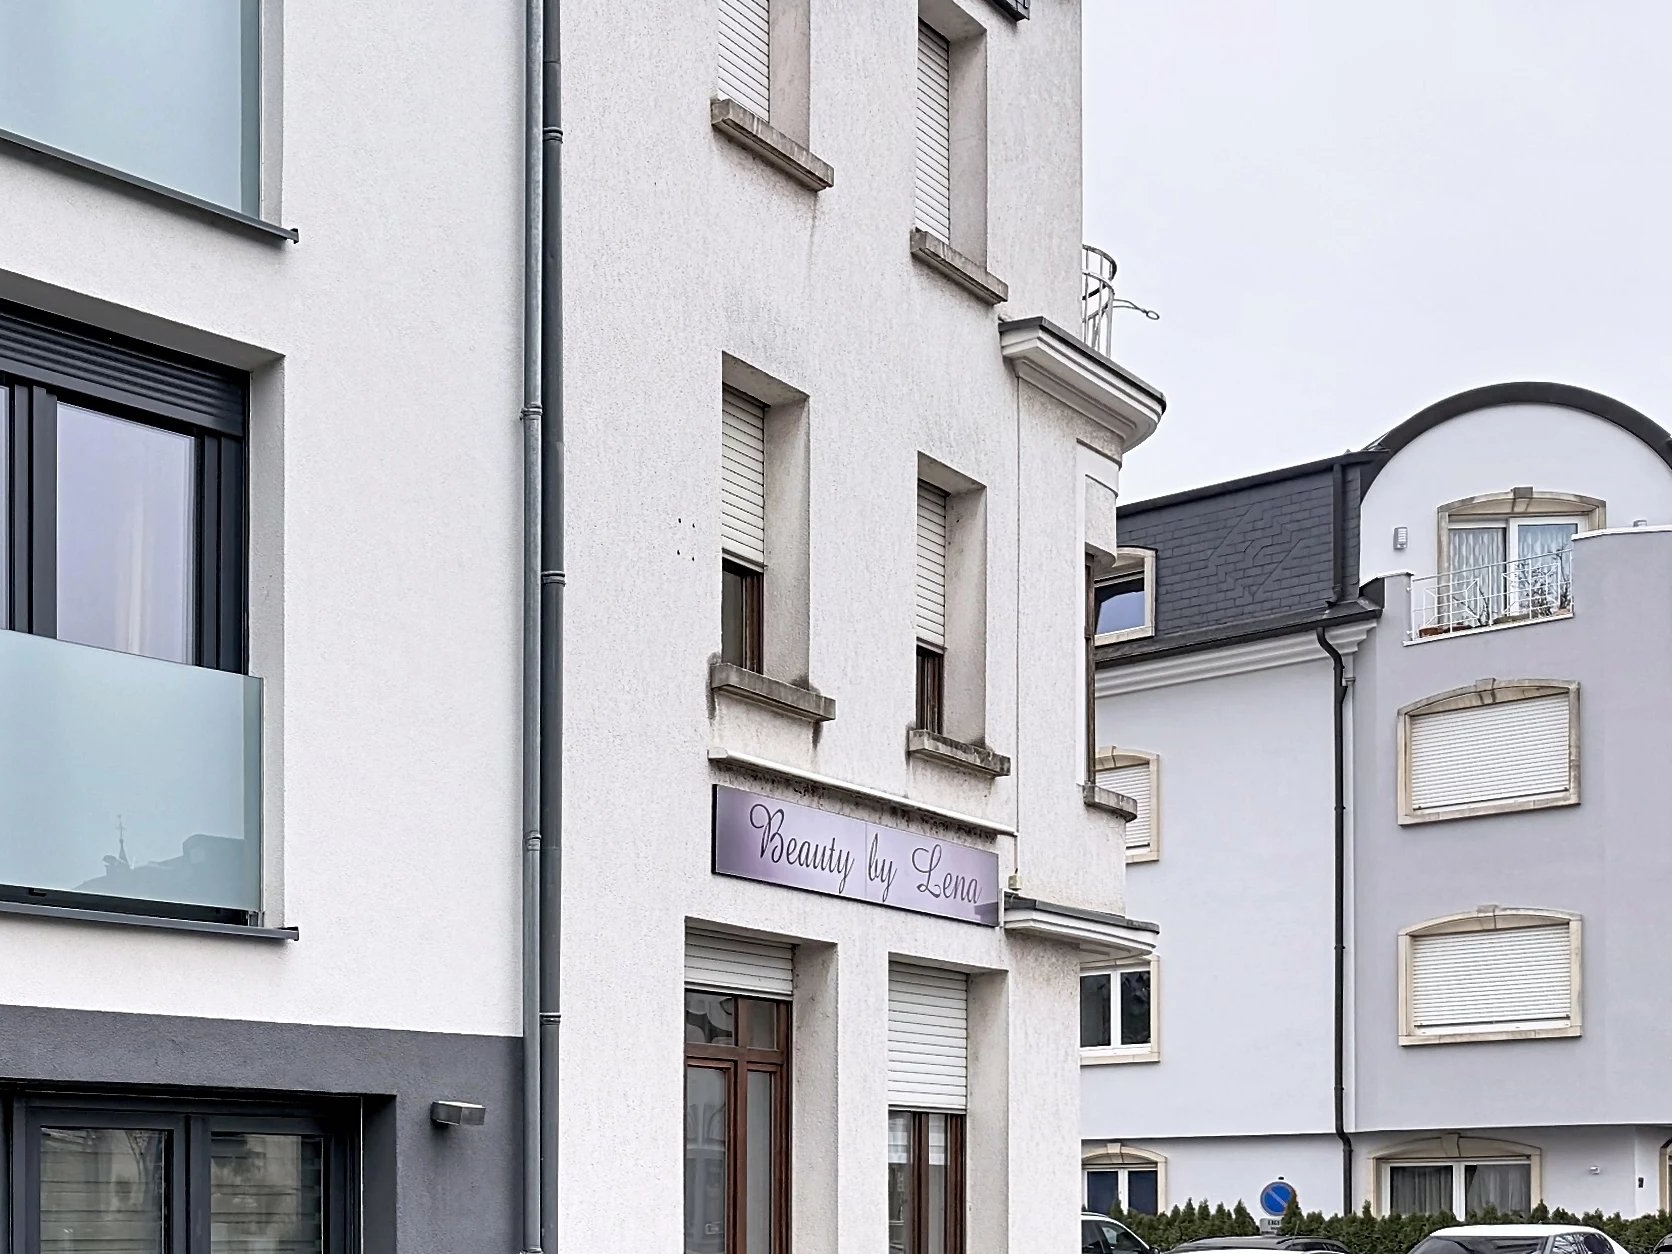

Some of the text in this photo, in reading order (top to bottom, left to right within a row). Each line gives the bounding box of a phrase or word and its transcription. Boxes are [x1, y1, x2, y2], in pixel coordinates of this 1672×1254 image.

[749, 803, 983, 904] Beauty by Lena
